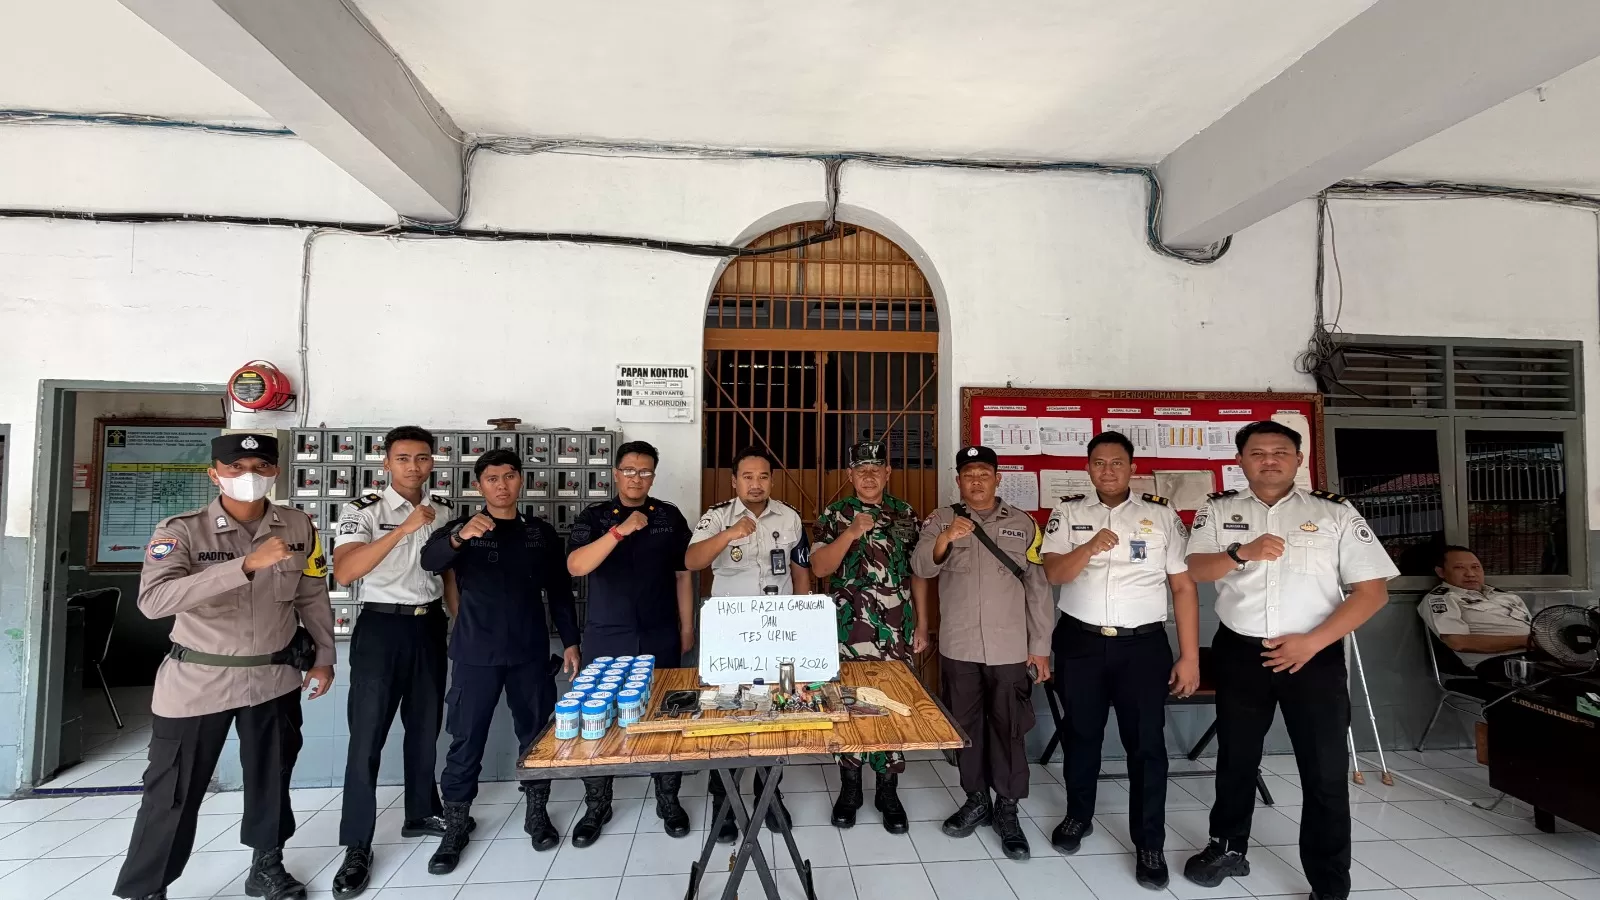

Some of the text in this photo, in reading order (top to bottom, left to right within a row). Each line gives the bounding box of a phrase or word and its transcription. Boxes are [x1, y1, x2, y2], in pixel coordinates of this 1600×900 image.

[621, 367, 688, 378] PAPAN KONTROL
[1120, 391, 1177, 399] PENGUMUMAN
[621, 398, 632, 406] PIKET
[1002, 529, 1024, 538] POLRI
[198, 551, 235, 561] RADITYA
[717, 598, 825, 616] HASIL RAZIA GABUNGAN
[761, 614, 777, 628] DAN
[738, 629, 798, 643] TES URINE
[799, 656, 829, 670] 2026
